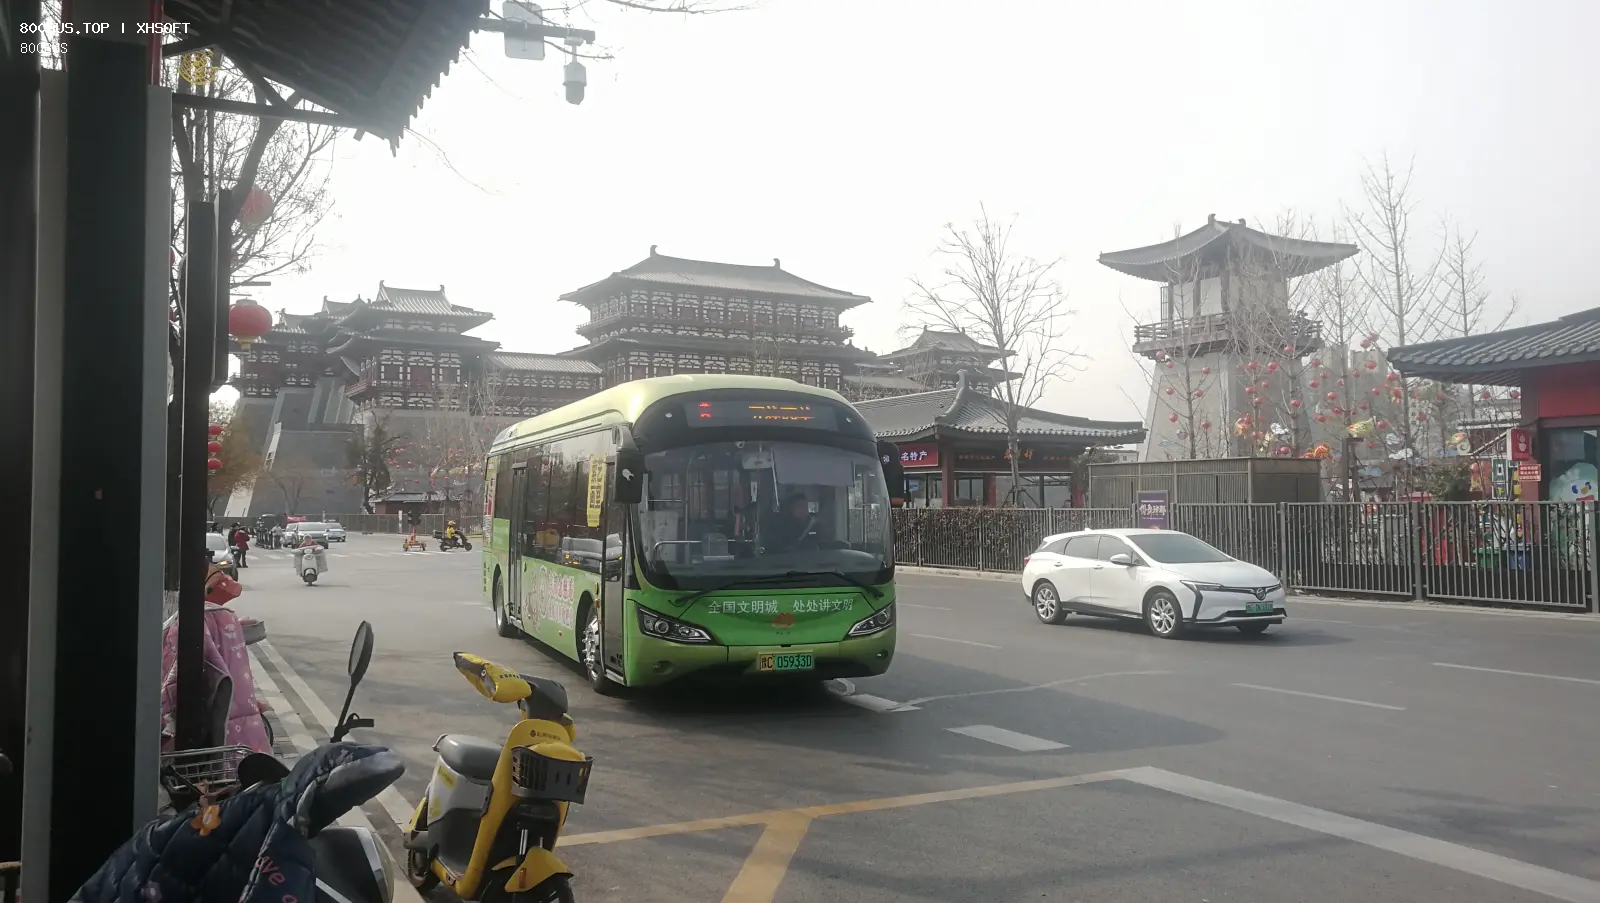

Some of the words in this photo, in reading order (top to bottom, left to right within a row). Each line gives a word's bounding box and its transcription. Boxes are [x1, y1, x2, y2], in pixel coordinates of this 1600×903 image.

[708, 600, 779, 614] 全国文明城
[793, 598, 854, 613] 处处讲文明
